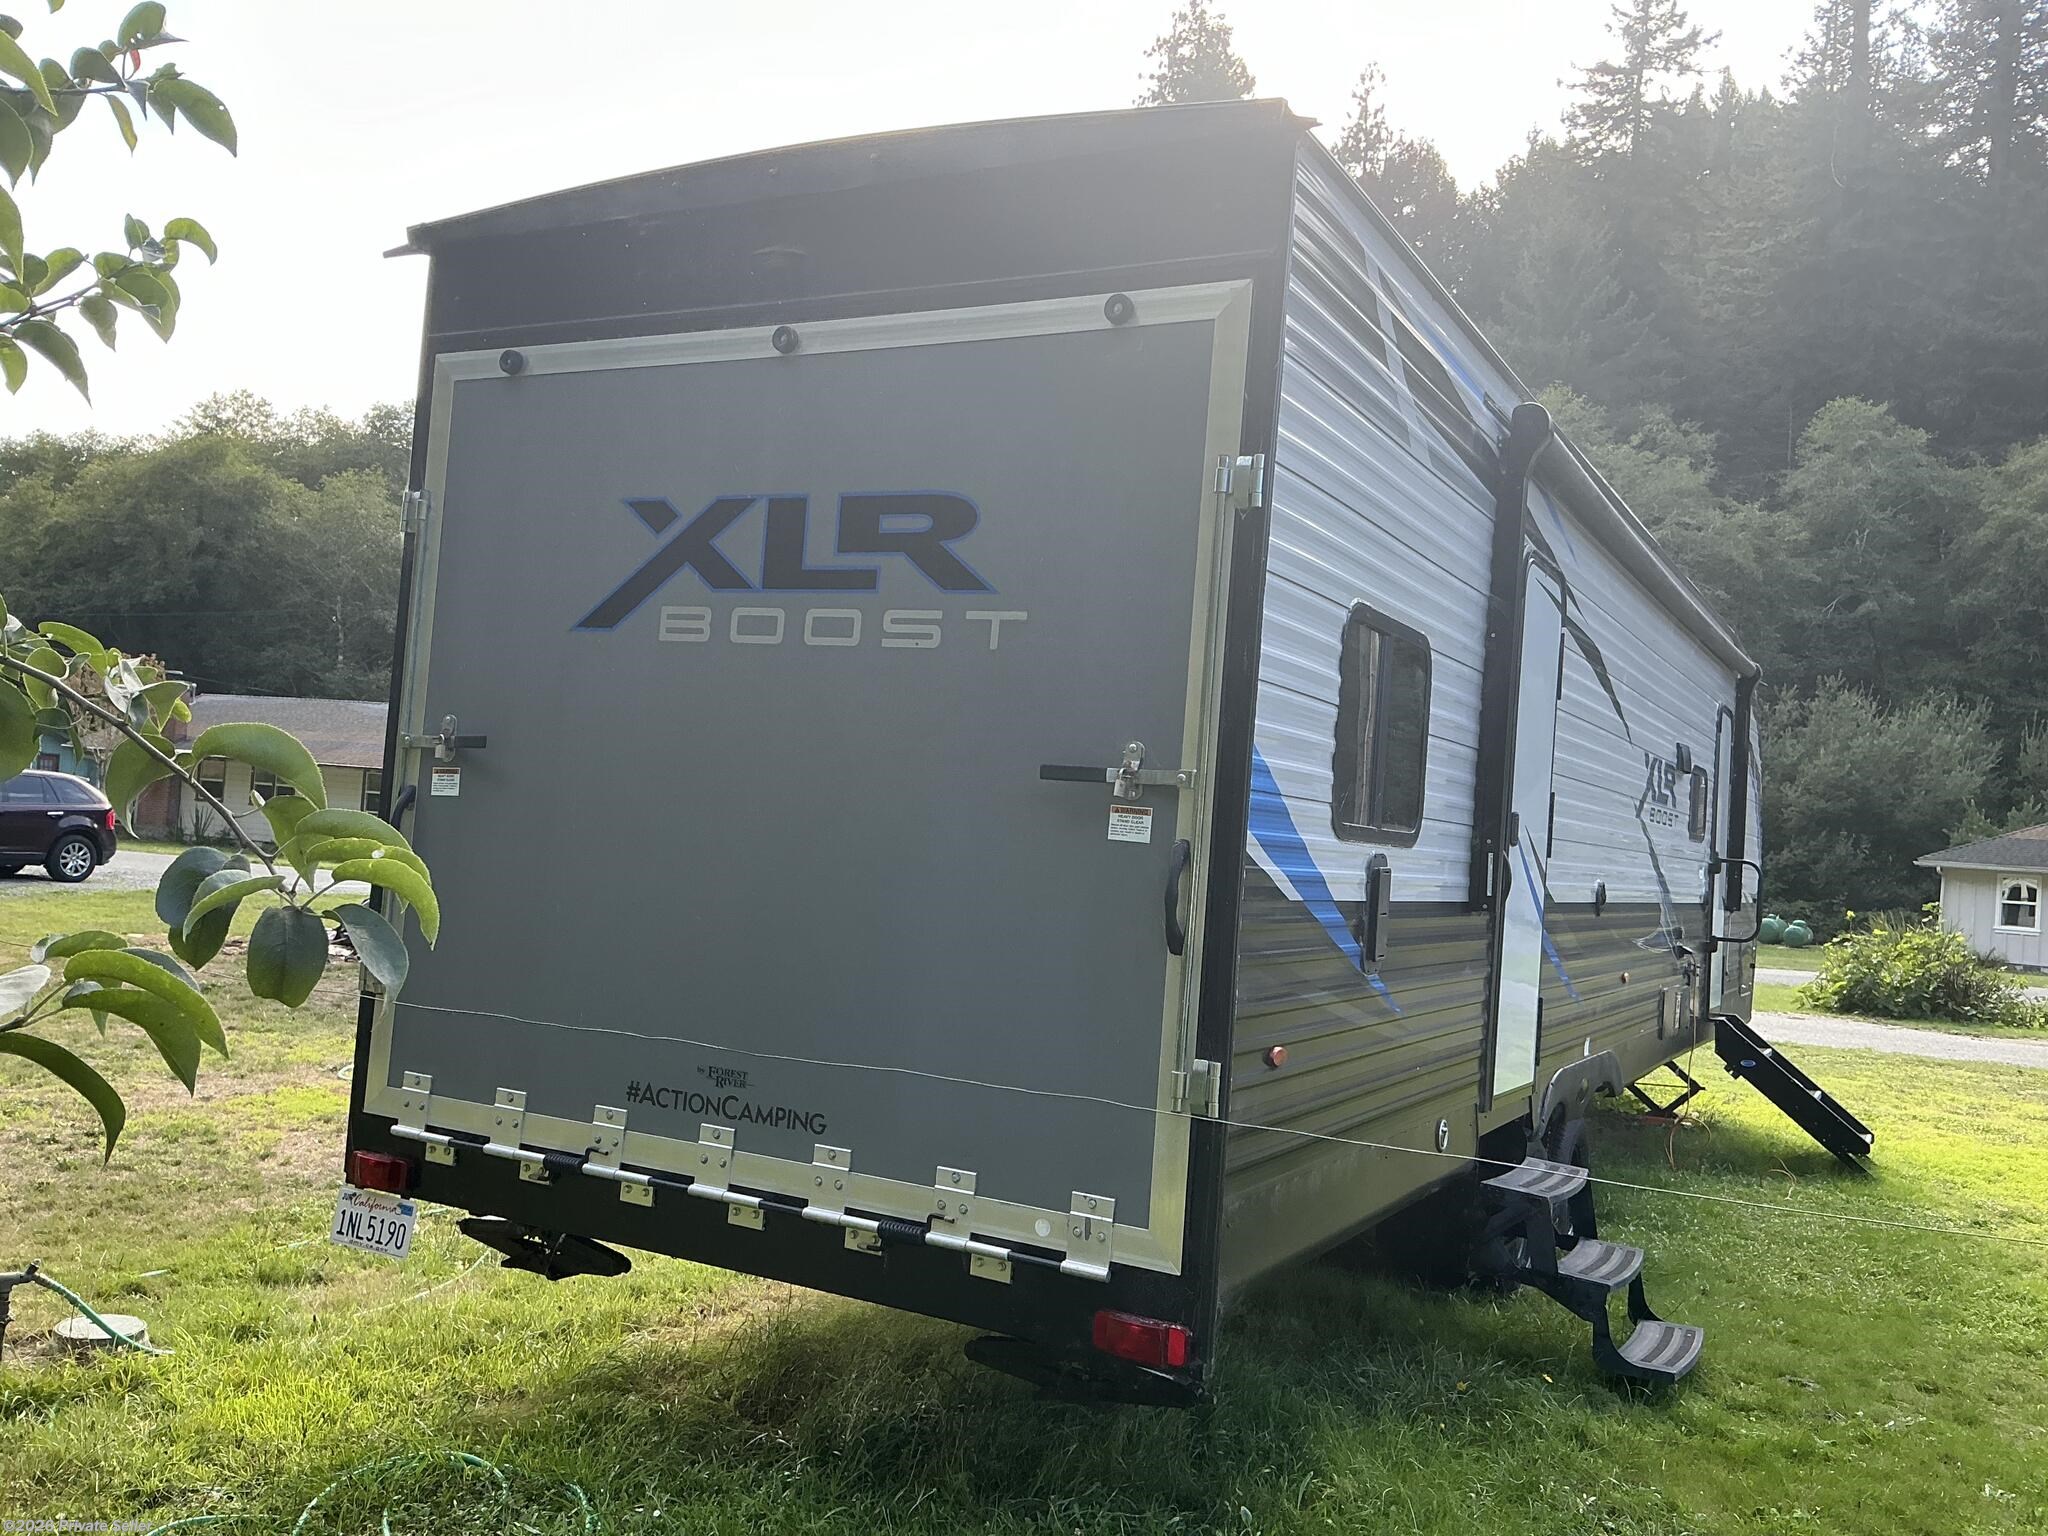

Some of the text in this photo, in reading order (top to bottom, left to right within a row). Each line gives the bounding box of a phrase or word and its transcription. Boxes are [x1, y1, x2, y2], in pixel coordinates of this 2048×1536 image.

[570, 490, 1000, 634] XLR
[658, 605, 1028, 651] BOOST
[1635, 752, 1676, 818] XLR
[1649, 807, 1680, 828] BOOST
[707, 1065, 749, 1080] FOREST
[715, 1076, 747, 1089] RIVER
[353, 1194, 401, 1216] California
[336, 1208, 407, 1250] 1NL5190
